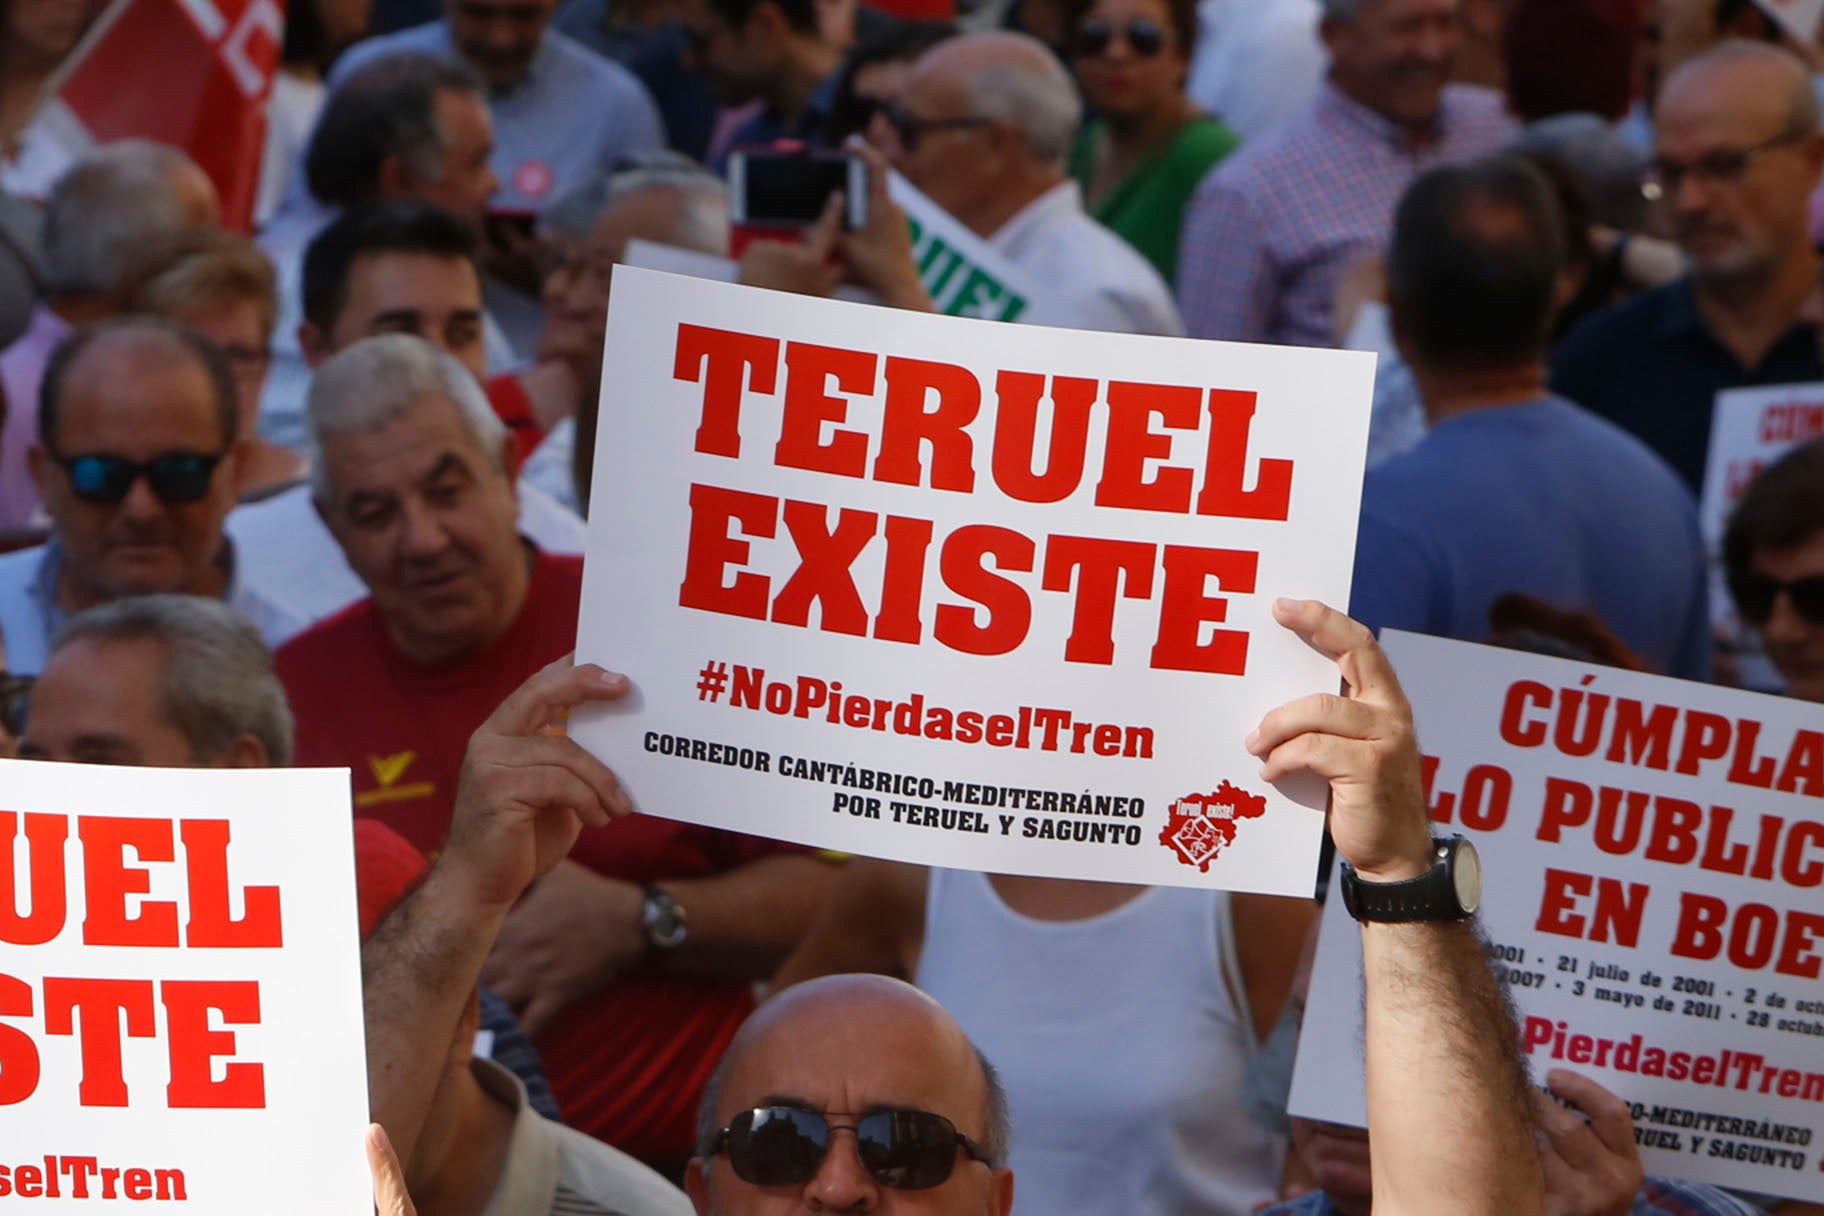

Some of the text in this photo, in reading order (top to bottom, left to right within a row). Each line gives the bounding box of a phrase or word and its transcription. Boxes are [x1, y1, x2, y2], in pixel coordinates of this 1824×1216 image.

[673, 322, 1294, 521] TERUEL
[678, 482, 1259, 677] EXISTE
[696, 659, 1155, 760] #NoPierdaselTren
[644, 731, 1146, 819] CORREDOR CANTÁBRICO-MEDITERRÁNEO
[832, 792, 1142, 846] POR TERUEL Y SAGUNTO
[1535, 868, 1824, 978] EN BOE
[1557, 955, 1578, 973] 21
[1587, 960, 1630, 983] julio
[1640, 970, 1663, 988] de
[1673, 976, 1716, 997] 2001
[1744, 987, 1757, 1004] 2
[1572, 980, 1585, 996] 3
[1594, 986, 1644, 1009] mayo
[1654, 995, 1674, 1012] de
[1683, 999, 1721, 1020] 2011
[1746, 1010, 1770, 1027] 28
[1691, 1136, 1703, 1153] Y
[1708, 1139, 1805, 1170] SAGUNTO
